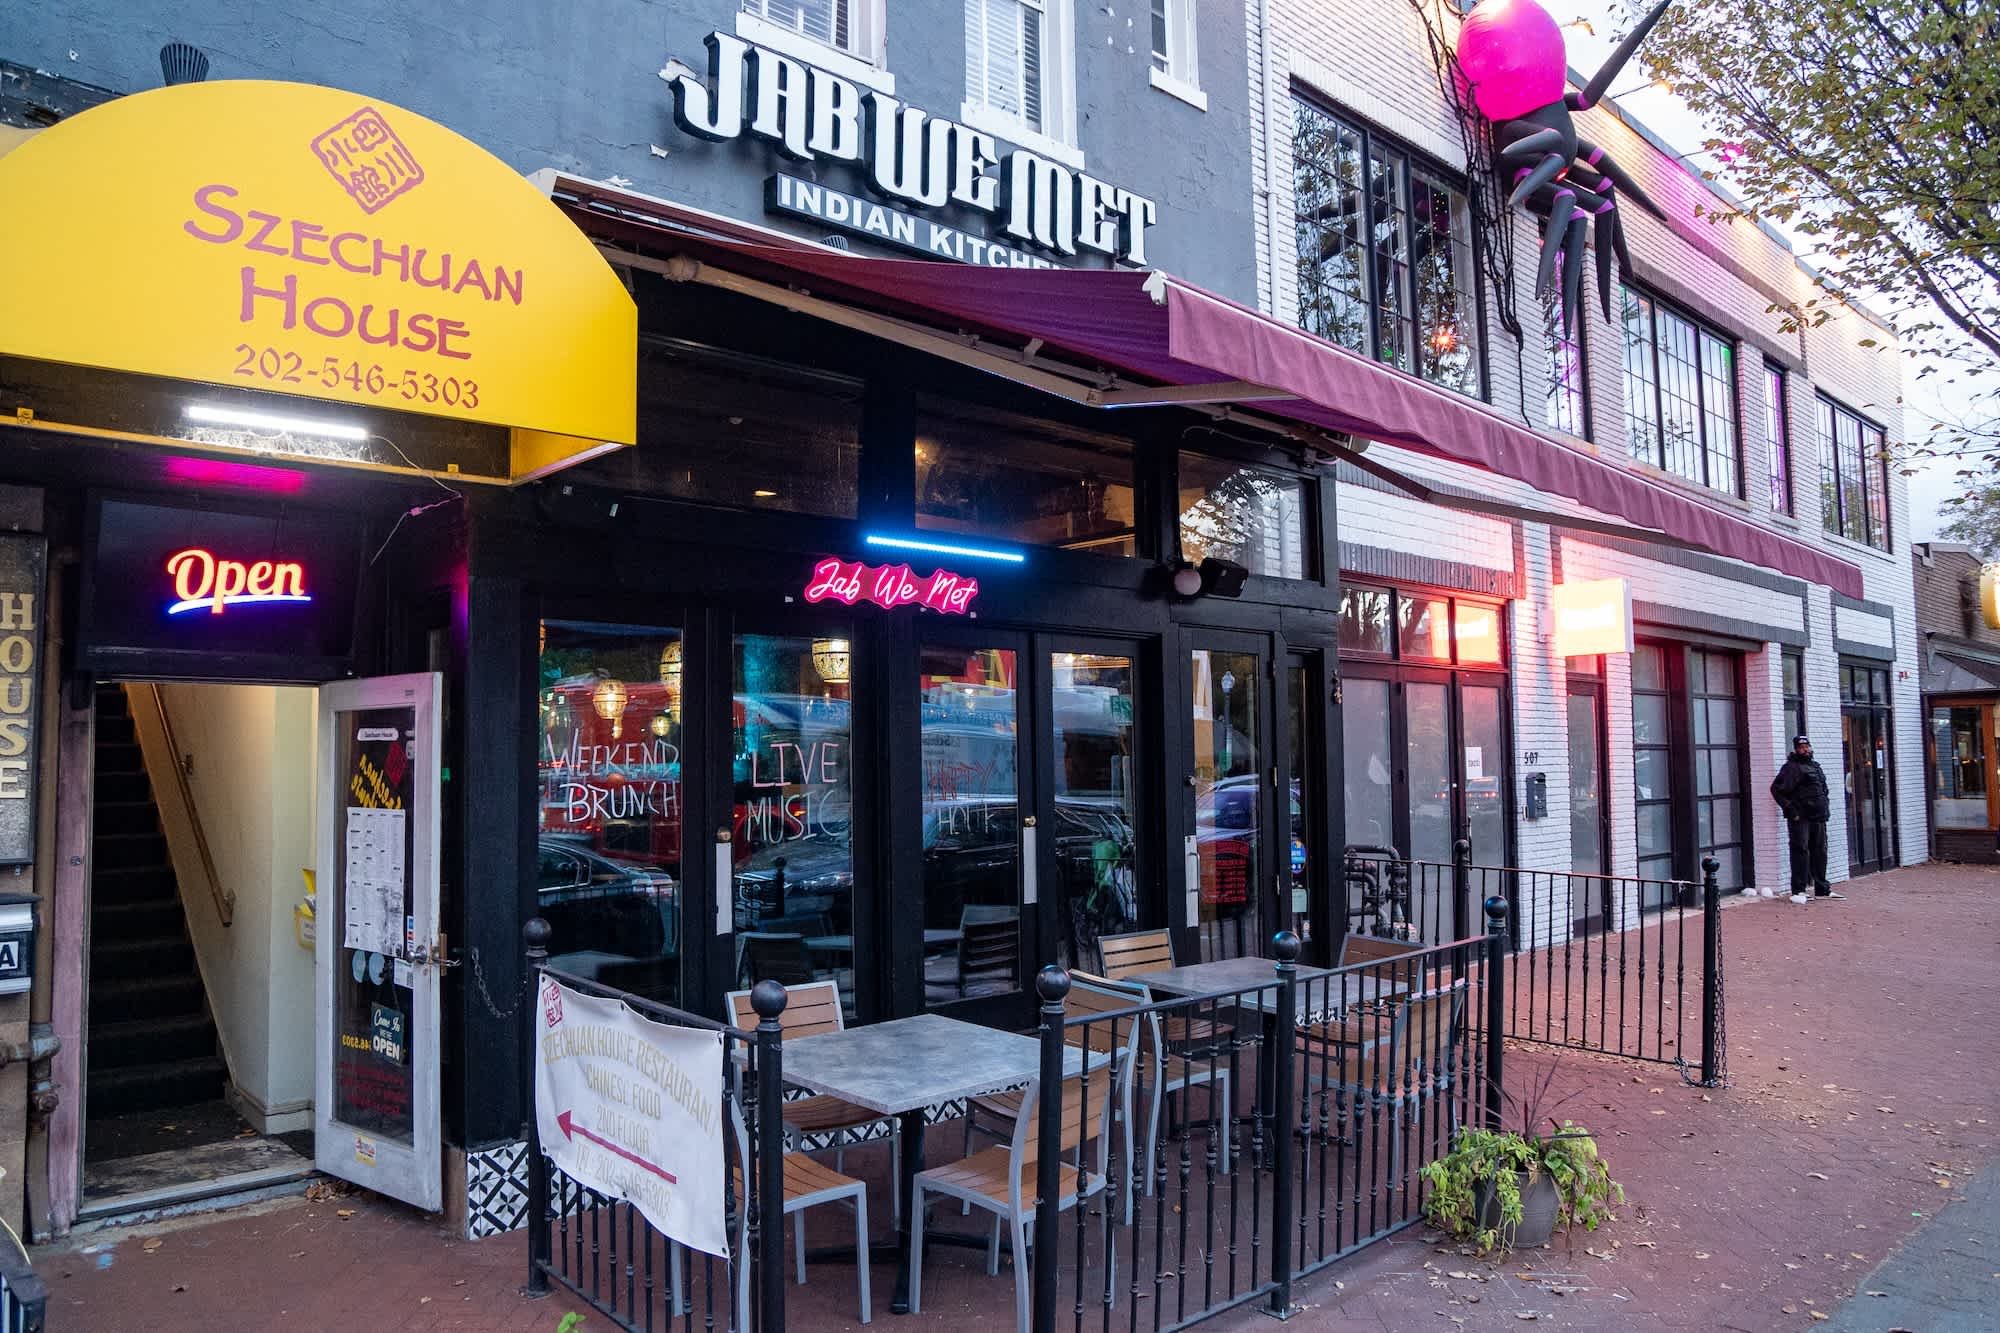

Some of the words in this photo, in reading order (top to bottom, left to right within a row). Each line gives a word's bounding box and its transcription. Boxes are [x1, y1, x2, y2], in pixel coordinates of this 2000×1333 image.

[183, 184, 523, 306] SZECHUAN
[780, 177, 916, 244] INDIAN
[929, 223, 1073, 270] KITCH
[239, 265, 472, 360] HOUSE
[233, 343, 480, 410] 202-546-5303
[167, 549, 305, 614] Open
[809, 561, 864, 601] Jab
[874, 567, 919, 606] We
[926, 572, 977, 611] Met
[0, 591, 36, 800] HOUSE
[545, 728, 680, 777] WEEKEND
[751, 742, 840, 788] LIVE
[559, 780, 678, 823] BRUNCH
[745, 789, 847, 844] MUSIC
[372, 1035, 400, 1061] OPEN
[597, 1026, 637, 1069] HOUSE
[632, 1082, 662, 1121] FOOD
